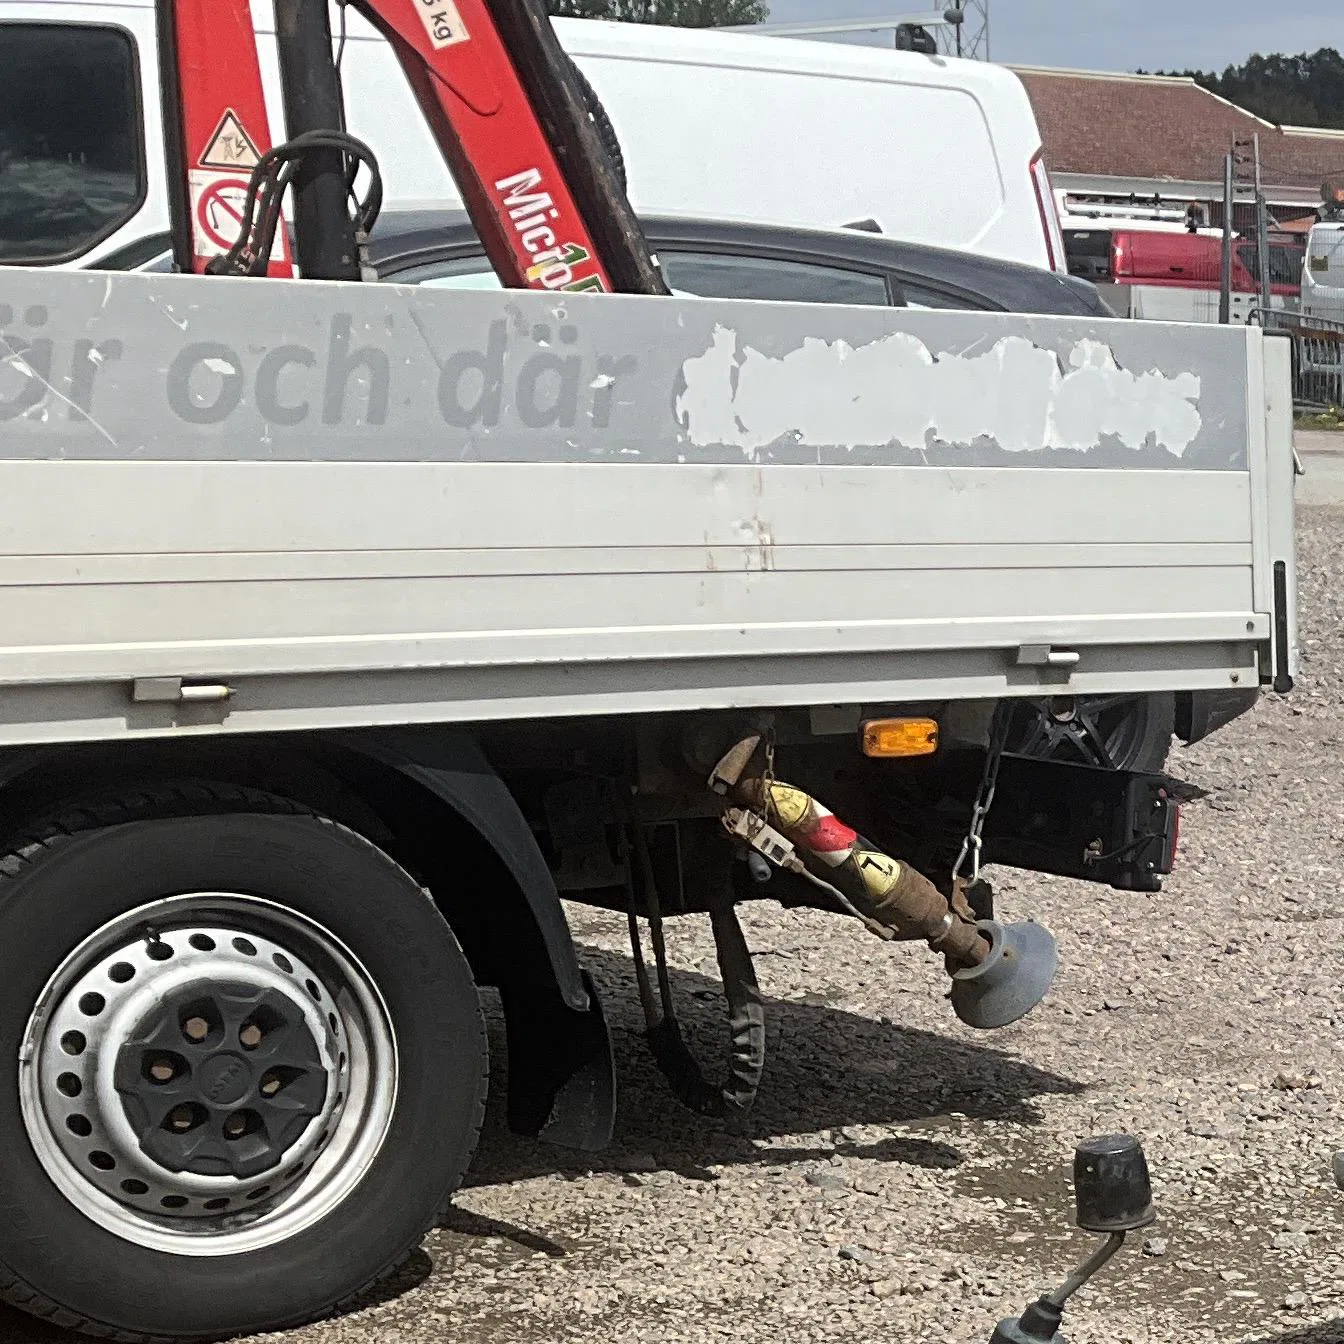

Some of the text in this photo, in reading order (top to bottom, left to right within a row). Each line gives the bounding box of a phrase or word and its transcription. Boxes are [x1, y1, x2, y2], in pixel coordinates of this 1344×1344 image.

[431, 11, 453, 40] kg
[495, 167, 574, 290] Micro
[167, 312, 392, 426] och
[437, 318, 638, 429] där
